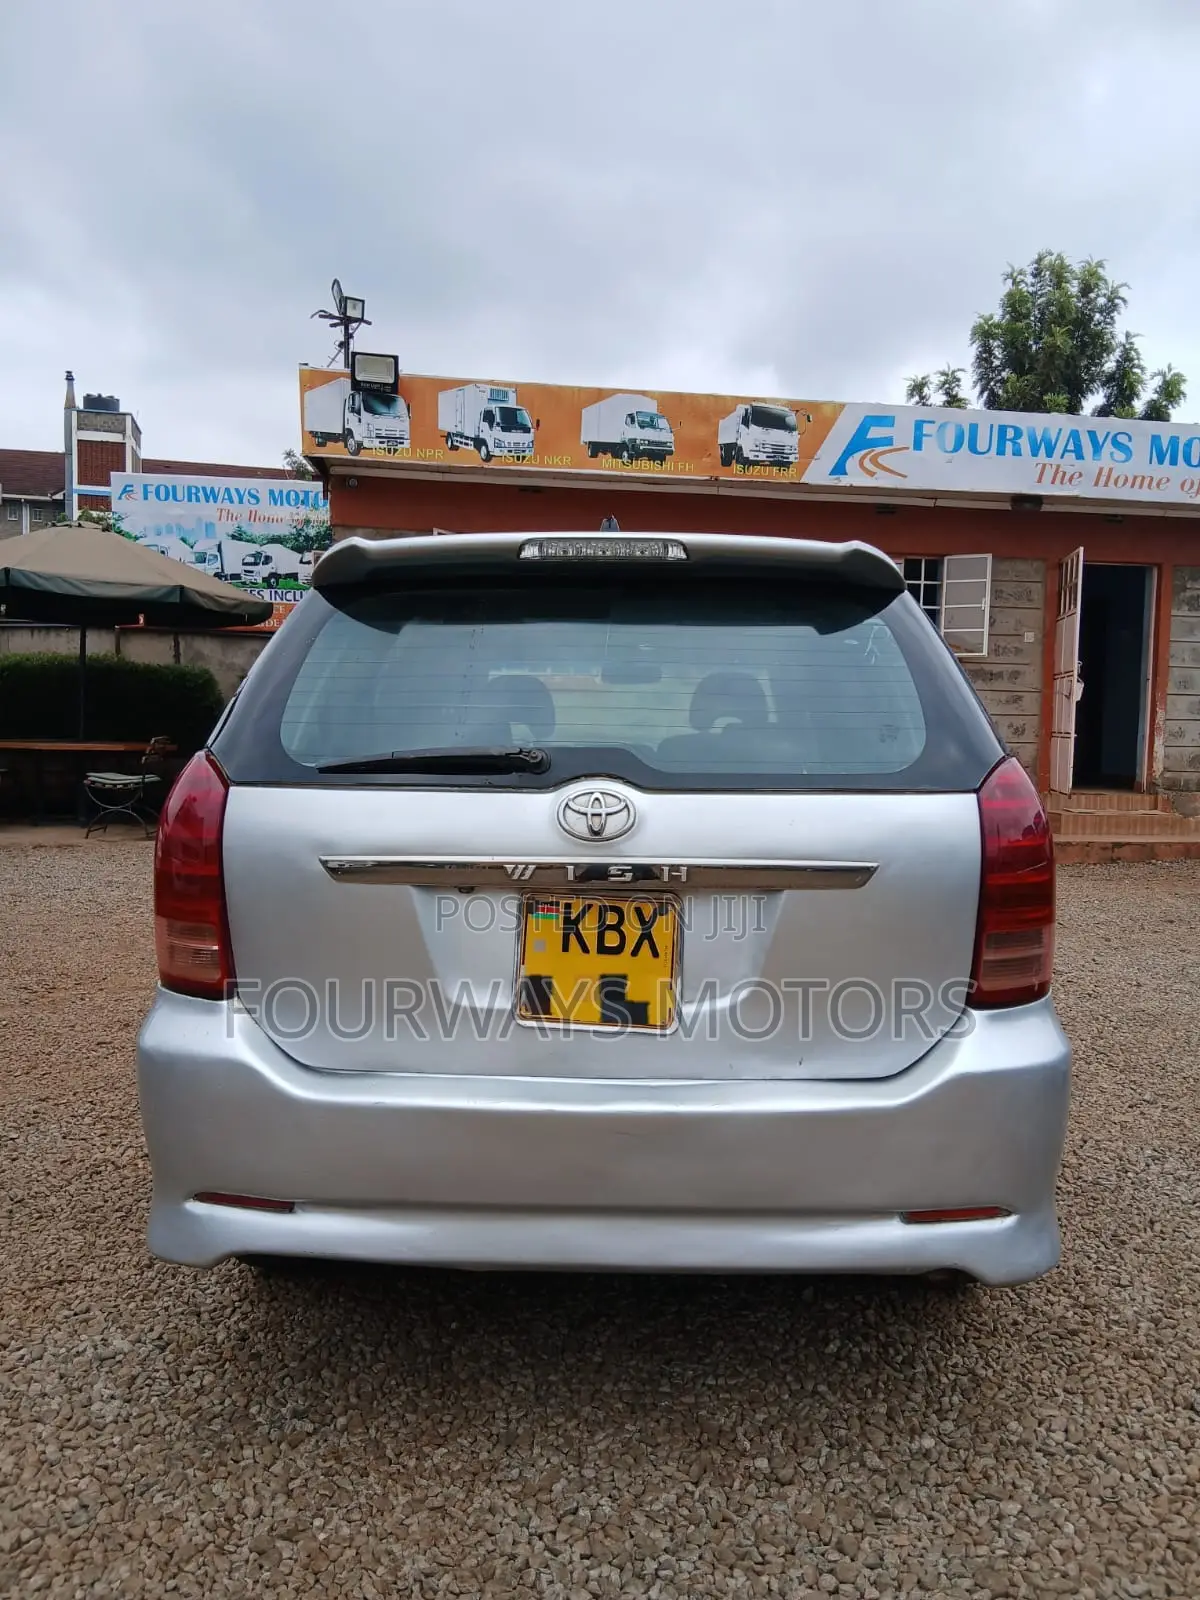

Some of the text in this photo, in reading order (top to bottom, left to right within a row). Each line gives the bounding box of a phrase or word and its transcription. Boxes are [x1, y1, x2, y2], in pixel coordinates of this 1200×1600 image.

[912, 418, 1133, 464] FOURWAYS
[372, 446, 444, 460] ISUZU NPR
[501, 454, 572, 466] ISUZU NKR
[602, 457, 694, 473] MITSUBISHI FH
[733, 464, 797, 478] ISUZU FRR
[1034, 462, 1083, 487] The
[1093, 466, 1170, 491] Home
[142, 483, 260, 506] FOURWAYS
[216, 507, 242, 523] The
[247, 508, 284, 525] Home
[503, 864, 688, 882] WISH
[561, 902, 660, 959] KBX
